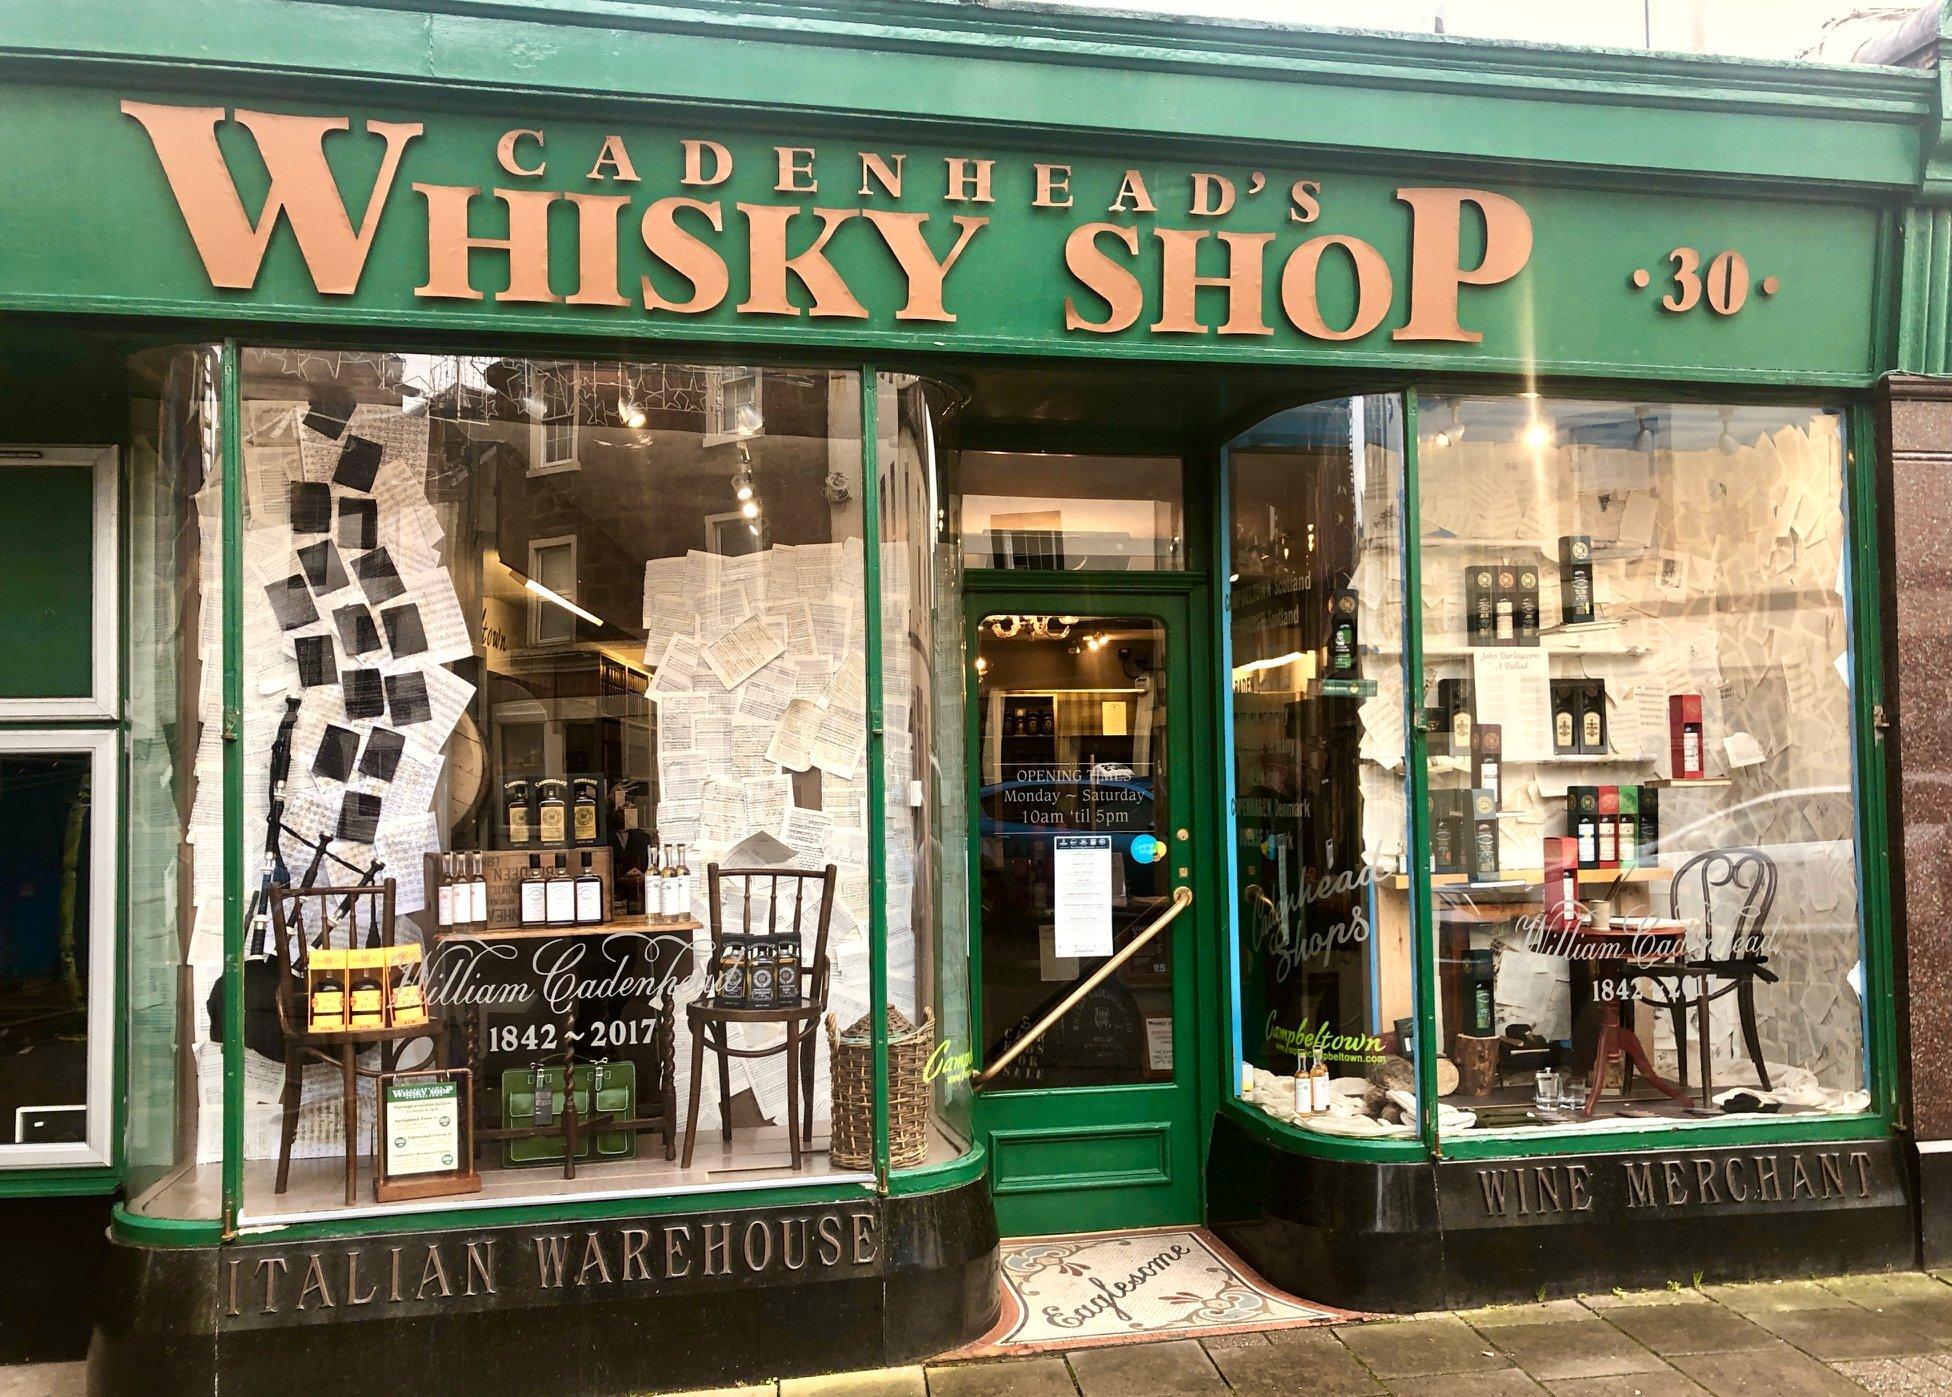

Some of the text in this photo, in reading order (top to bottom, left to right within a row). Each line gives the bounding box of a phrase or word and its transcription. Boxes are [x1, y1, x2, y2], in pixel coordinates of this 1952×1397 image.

[497, 128, 1321, 224] CADENHEAD'S
[121, 99, 1534, 342] WHISKY SHOP
[1003, 789, 1061, 805] Monday
[1082, 788, 1145, 804] Saturday
[1016, 769, 1132, 783] OPENING TIMES
[1022, 810, 1064, 824] 10am
[1096, 809, 1129, 827] 5pm
[1274, 798, 1311, 818] Denmark
[1515, 900, 1783, 970] William Cadead
[387, 932, 747, 1014] William Cadenhead
[1592, 977, 1643, 1002] 1842
[489, 1023, 558, 1052] 1842
[591, 1018, 657, 1047] 2017
[1265, 1009, 1387, 1054] Campbeltown
[1477, 1152, 1872, 1217] WINE MERCHANT
[227, 1213, 879, 1317] ITALIAN WAREHOUSE
[1042, 1242, 1191, 1328] Eaglesome
